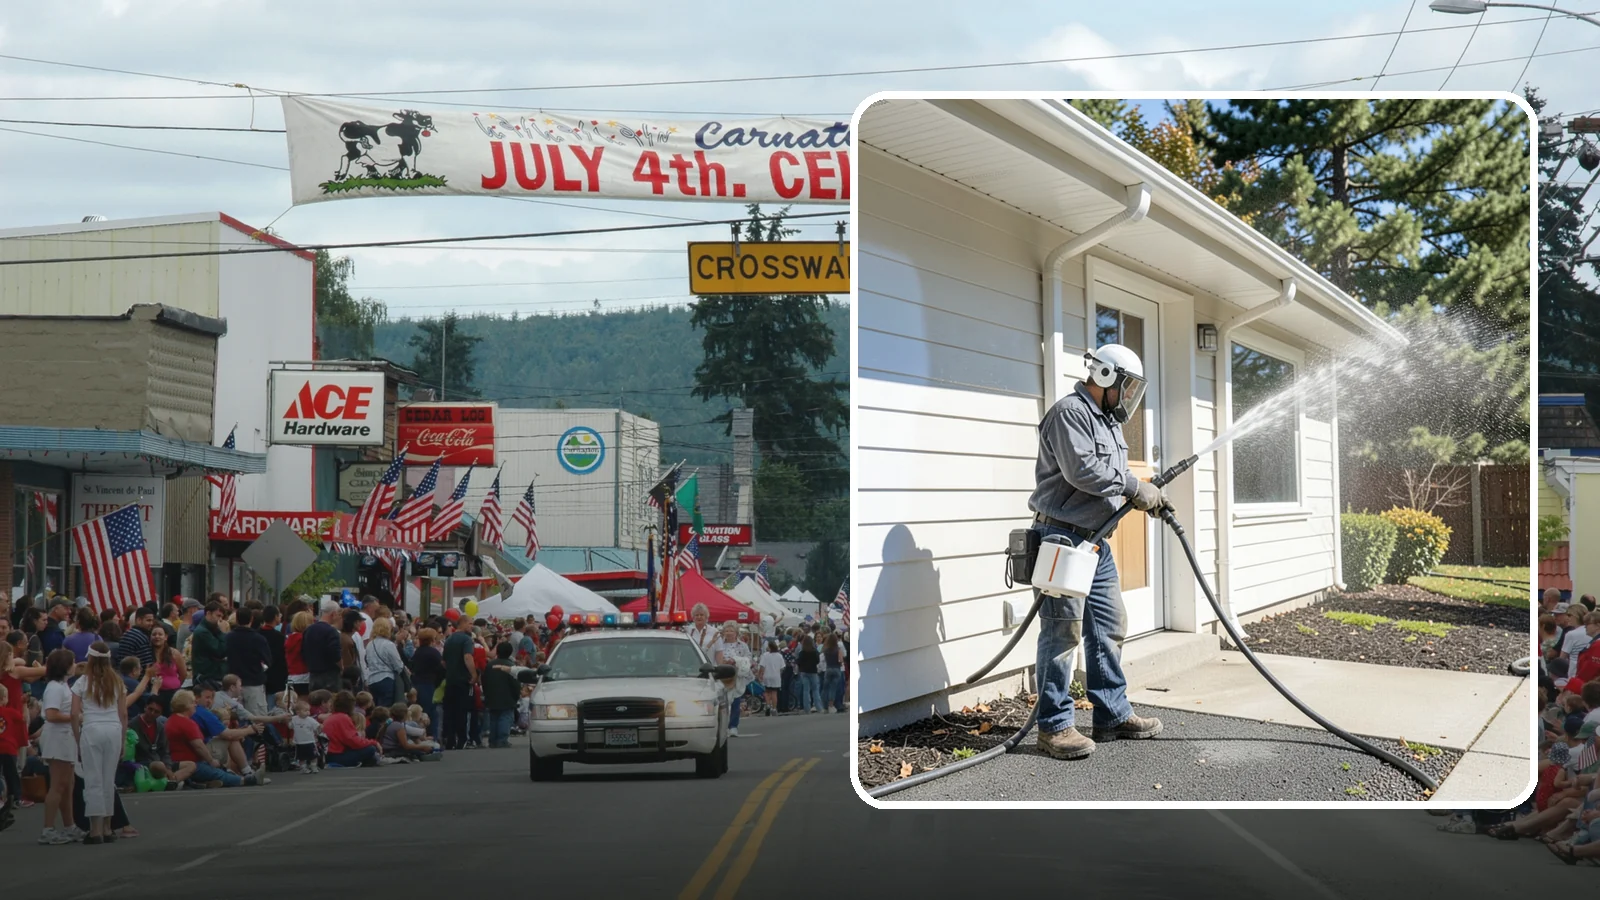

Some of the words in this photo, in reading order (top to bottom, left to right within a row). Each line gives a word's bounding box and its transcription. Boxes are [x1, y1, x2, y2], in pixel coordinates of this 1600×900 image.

[695, 121, 850, 149] Carnat
[481, 141, 605, 192] JULY
[632, 150, 746, 198] 4th.
[697, 254, 850, 280] CROSSWA
[282, 380, 373, 420] ACE
[406, 409, 452, 422] CEDAR
[461, 409, 485, 422] LOG
[283, 421, 371, 437] Hardware
[416, 428, 476, 446] Coca-Cola
[354, 467, 385, 480] Simpl
[95, 484, 124, 495] Vincent
[126, 486, 136, 495] de
[138, 486, 155, 495] Paul
[688, 526, 741, 535] CRNATION
[699, 535, 730, 543] GLASS
